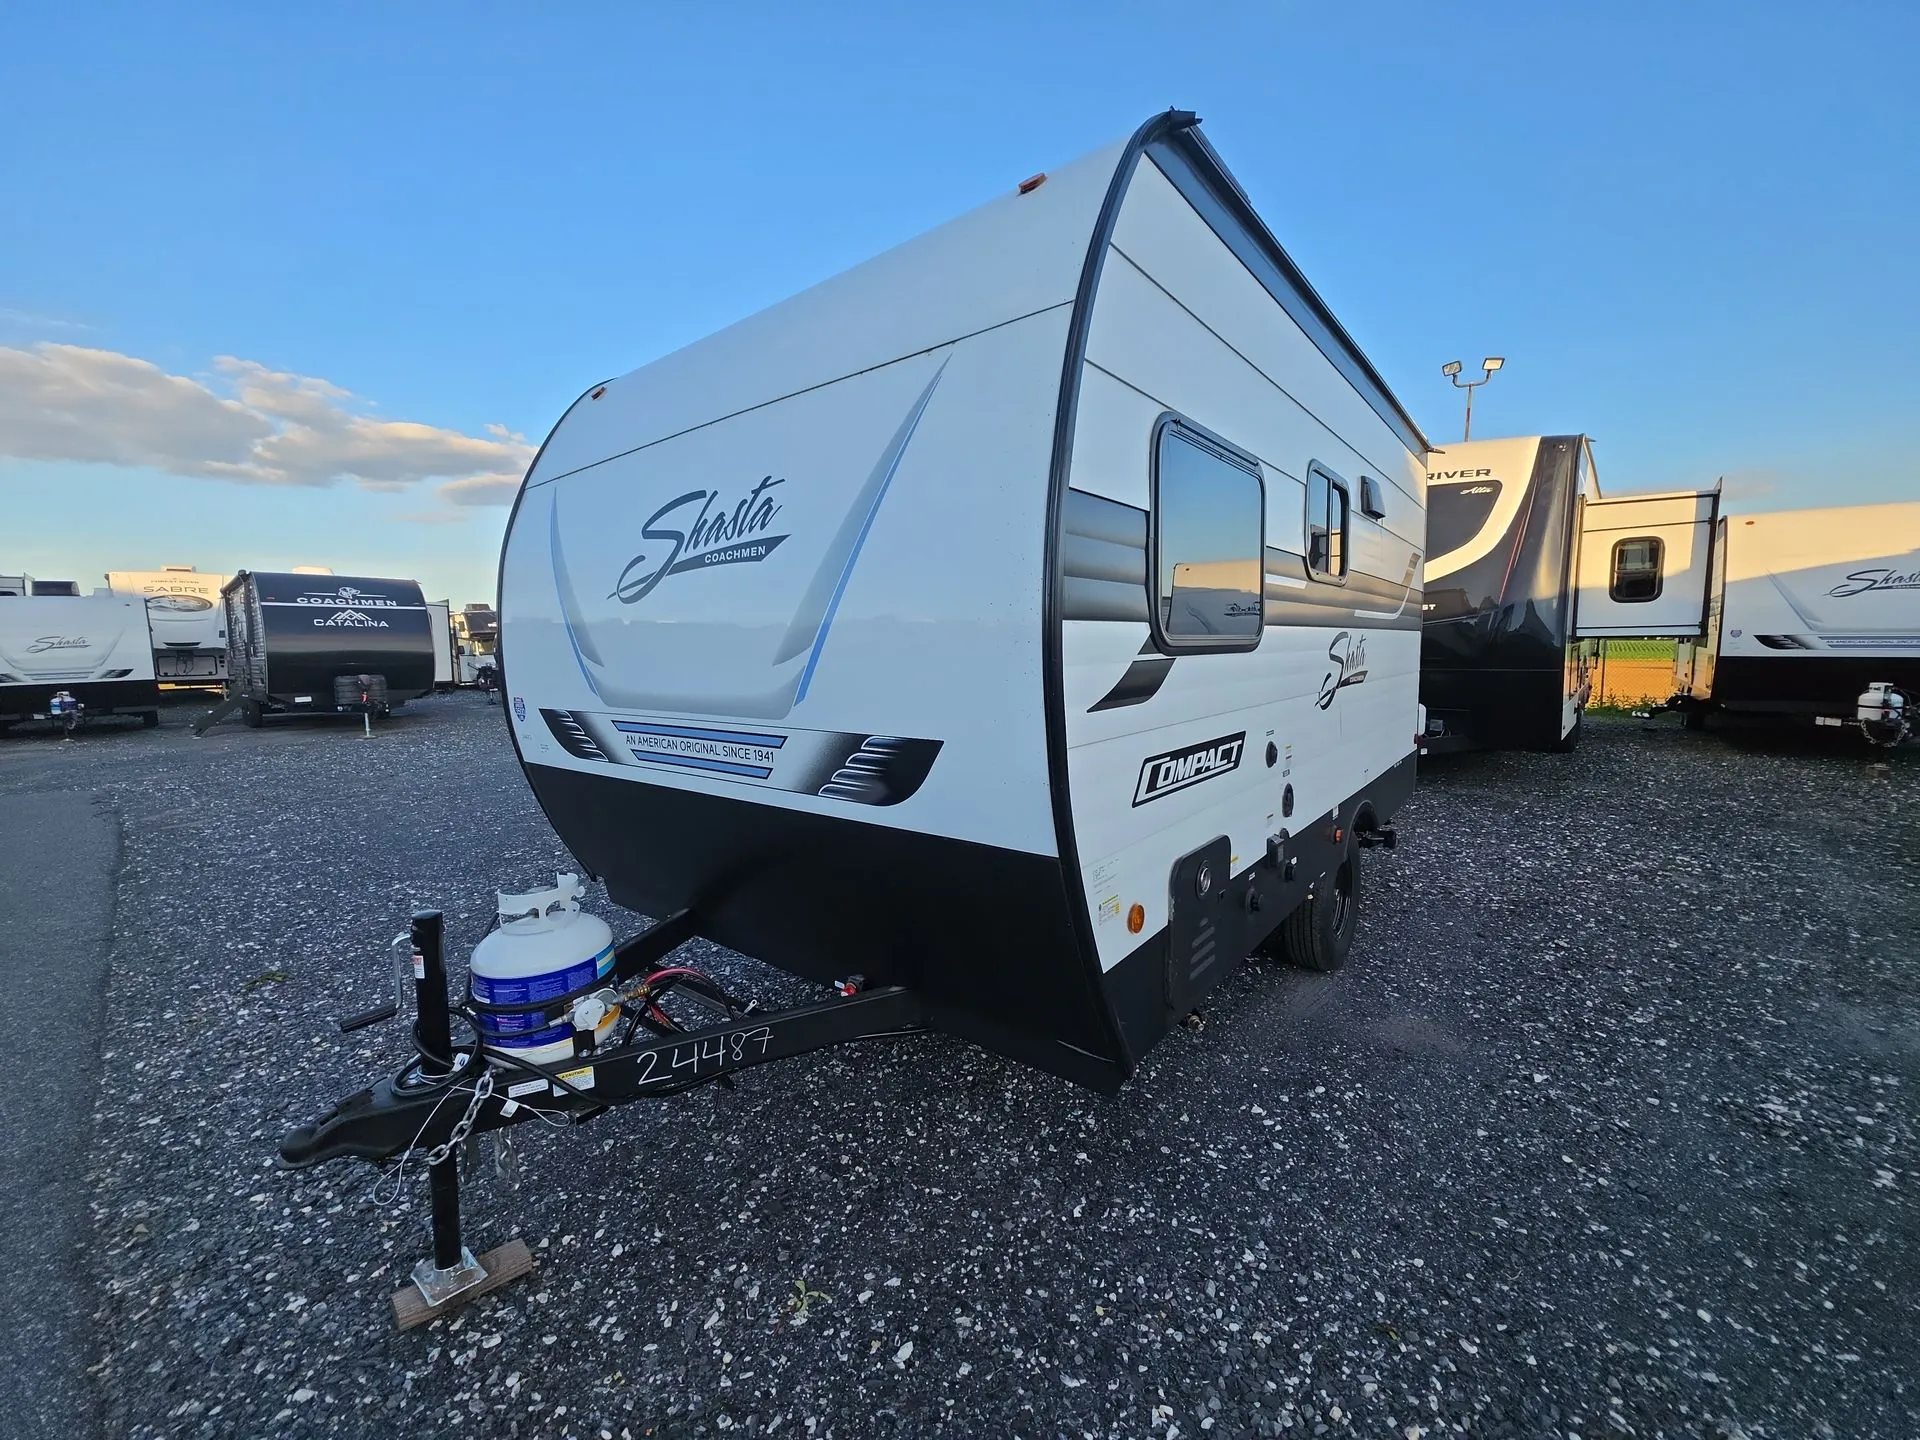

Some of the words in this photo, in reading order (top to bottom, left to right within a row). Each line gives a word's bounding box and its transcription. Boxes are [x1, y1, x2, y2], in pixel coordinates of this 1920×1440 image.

[1427, 469, 1491, 480] RIVER
[616, 475, 786, 604] Shasta
[704, 545, 766, 563] COACHMEN
[143, 586, 209, 594] SABRE
[296, 597, 397, 606] COACHMEN
[313, 619, 389, 627] CATALINA
[26, 635, 88, 653] Shasta
[1318, 631, 1367, 711] Shasta
[626, 735, 636, 745] AN
[638, 736, 678, 750] AMERICAN
[680, 741, 720, 756] ORIGINAL
[723, 745, 751, 760] SINCE
[753, 750, 774, 763] 1941
[1135, 740, 1242, 803] COMPACT
[637, 1027, 774, 1085] 24487
